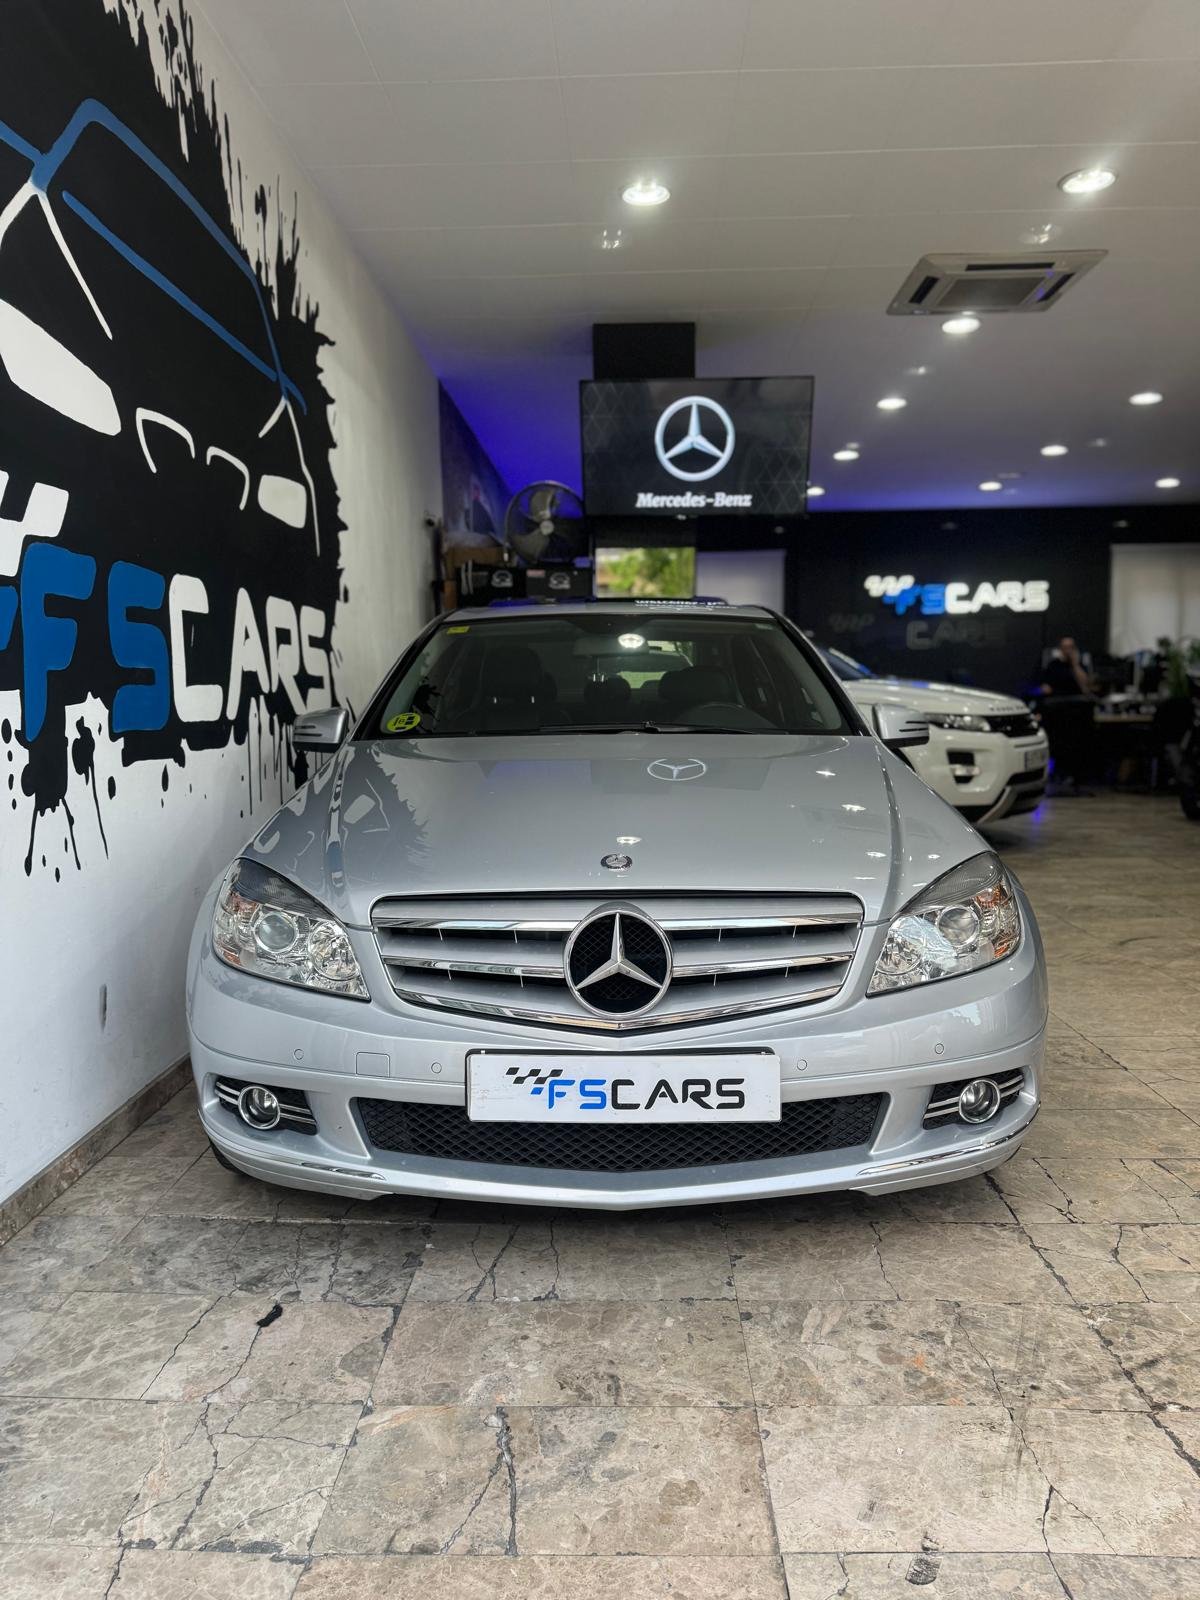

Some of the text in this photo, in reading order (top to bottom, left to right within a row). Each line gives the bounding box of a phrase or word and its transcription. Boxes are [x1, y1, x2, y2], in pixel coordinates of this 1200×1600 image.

[635, 491, 753, 508] Mercedes-Benz
[20, 542, 333, 742] FSCARS
[548, 1078, 745, 1110] FSCARS
